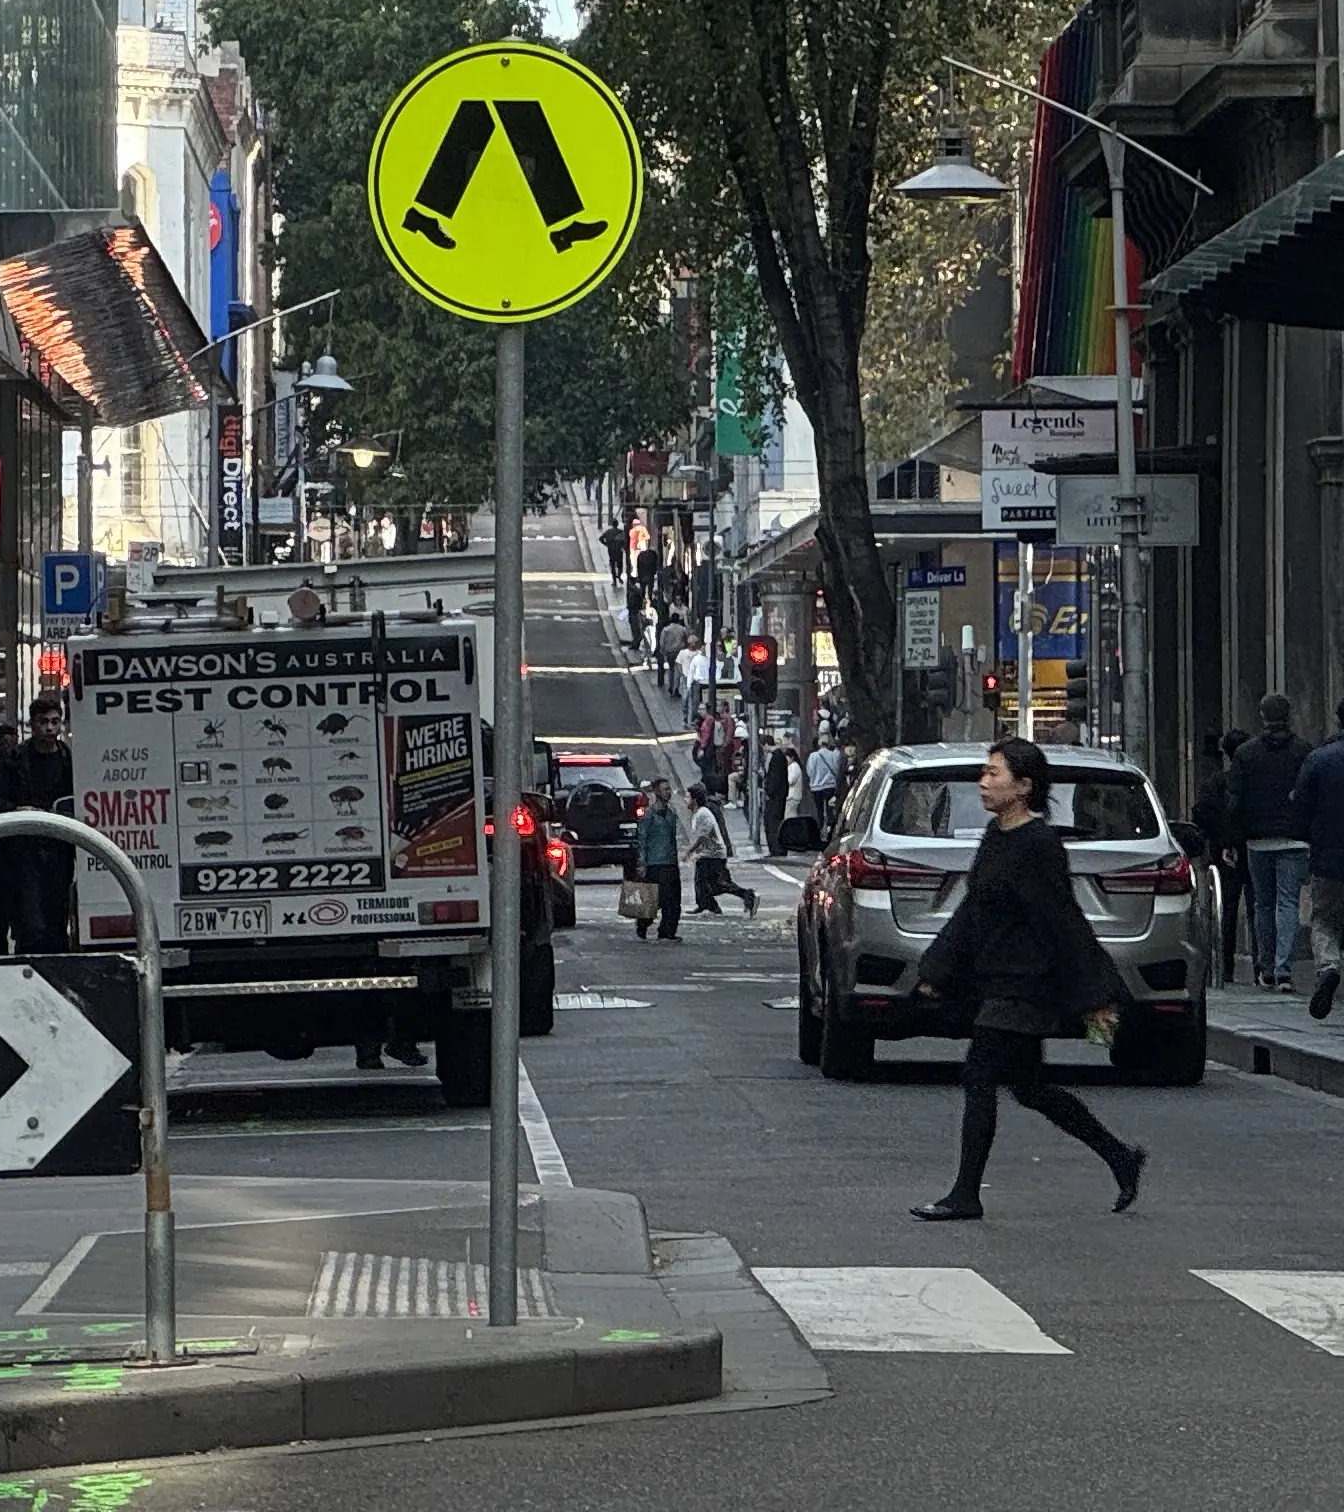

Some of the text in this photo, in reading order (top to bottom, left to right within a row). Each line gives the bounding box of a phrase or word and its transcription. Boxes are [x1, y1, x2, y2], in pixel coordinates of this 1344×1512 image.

[1011, 412, 1085, 434] Legends
[55, 564, 80, 607] P
[927, 570, 964, 584] Driver La
[46, 627, 73, 639] AREA
[97, 647, 446, 681] DAWSON'S AUSTRALIA
[95, 678, 451, 715] PEST CONTROL
[405, 716, 465, 750] WE'RE
[101, 747, 150, 763] ASK US
[405, 737, 468, 772] HIRING
[102, 768, 148, 782] ABOUT
[83, 788, 171, 828] SMART
[87, 853, 172, 872] PES NTROL
[197, 863, 372, 892] 9222 2222
[183, 909, 264, 932] 2BW 7GY
[350, 911, 416, 925] PROFESSIONAL
